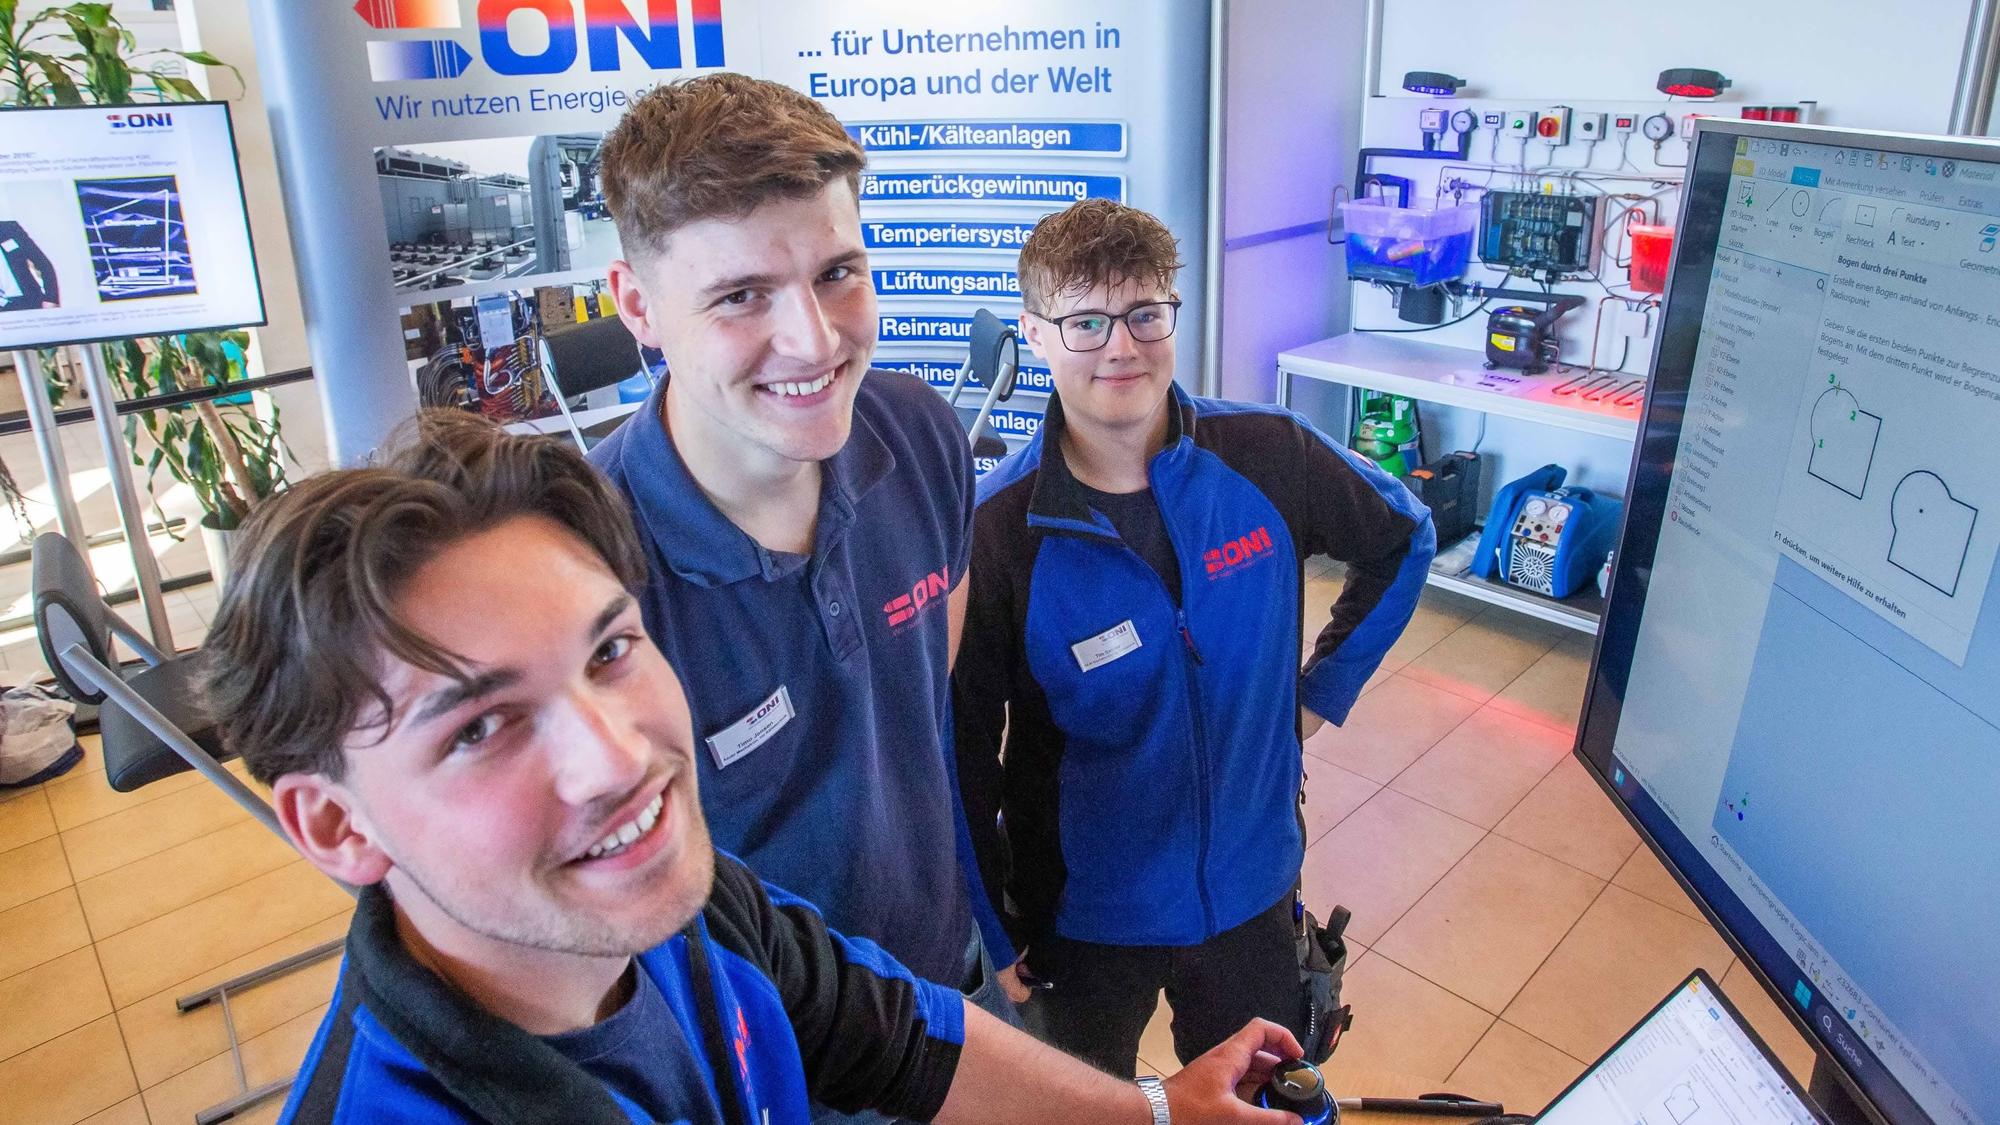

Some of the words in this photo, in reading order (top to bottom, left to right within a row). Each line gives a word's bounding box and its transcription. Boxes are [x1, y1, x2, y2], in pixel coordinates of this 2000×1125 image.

[477, 0, 725, 75] ONI
[831, 31, 873, 56] für
[882, 25, 1086, 54] Unternehmen
[1095, 22, 1120, 49] in
[809, 73, 916, 101] Europa
[927, 69, 981, 94] und
[990, 68, 1039, 94] der
[1047, 66, 1112, 93] Welt
[375, 95, 422, 120] Wir
[432, 93, 521, 117] nutzen
[530, 86, 627, 113] Energie
[128, 113, 173, 127] ONI
[860, 124, 1071, 148] Kühl-/Kälteanlagen
[859, 175, 1088, 199] ärmerückgewinnung
[1905, 213, 1941, 230] Rundung
[869, 224, 1033, 247] Temperiersyste
[1902, 236, 1915, 248] Text
[1838, 255, 1859, 268] Bogen
[1861, 261, 1881, 274] durch
[1882, 266, 1898, 278] drei
[1899, 270, 1928, 285] Punkte
[881, 272, 1021, 294] Lüftungsanla
[1833, 275, 1855, 288] Erstellt
[1855, 282, 1874, 292] einen
[1875, 286, 1899, 301] Bogen
[1899, 294, 1928, 308] anhand
[1928, 300, 1943, 311] von
[1824, 318, 1845, 332] Geben
[1869, 334, 1890, 347] ersten
[1892, 340, 1917, 357] beiden
[1918, 349, 1945, 365] Punkte
[1828, 374, 1836, 384] 3
[1911, 363, 1934, 378] Punkt
[1850, 410, 1857, 421] 2
[1818, 439, 1824, 449] 1
[1223, 526, 1273, 566] ONI
[912, 564, 949, 610] ON
[1782, 536, 1808, 559] drücken,
[1809, 555, 1820, 565] um
[1821, 562, 1846, 581] weitere
[1847, 575, 1864, 593] Hilfe
[1865, 589, 1874, 599] zu
[1875, 595, 1906, 619] erhalten
[757, 696, 780, 718] ONI
[1836, 1032, 1863, 1068] Suche
